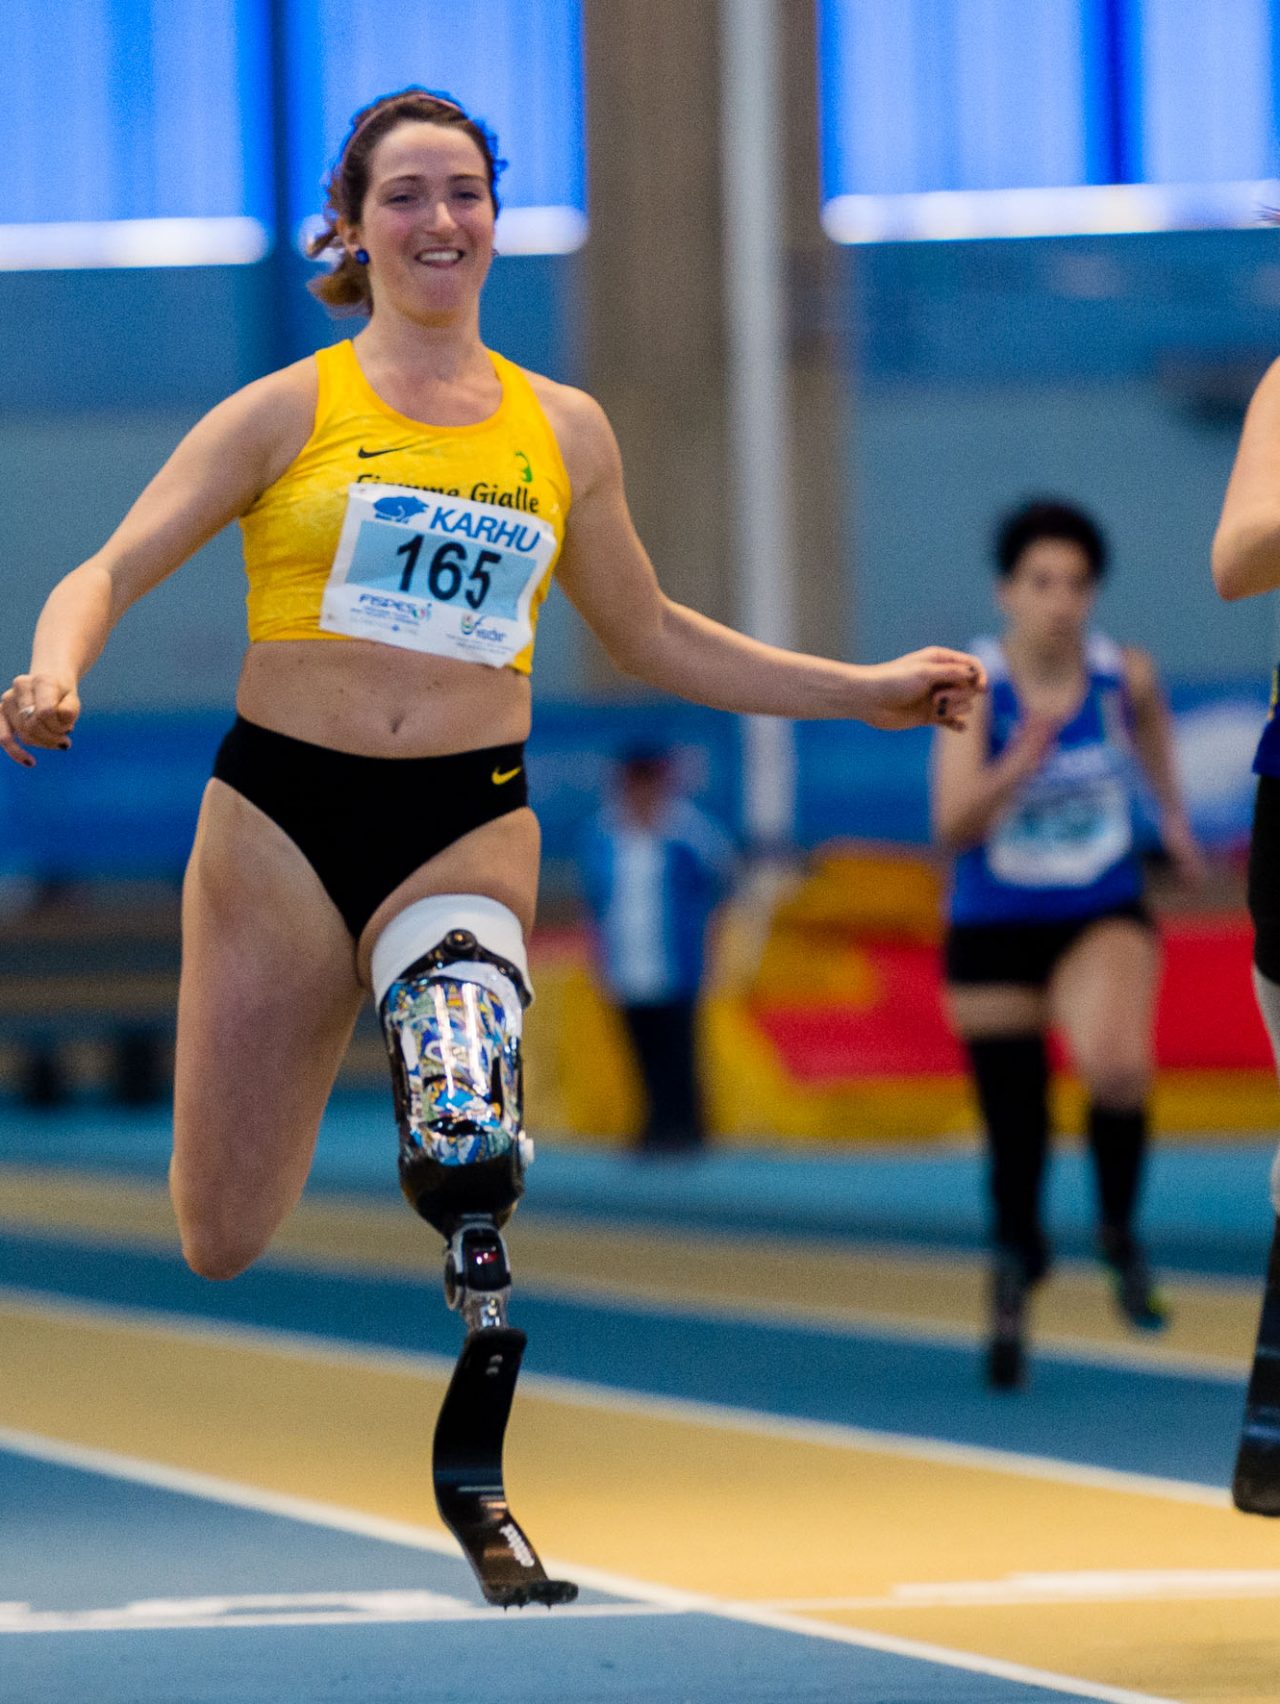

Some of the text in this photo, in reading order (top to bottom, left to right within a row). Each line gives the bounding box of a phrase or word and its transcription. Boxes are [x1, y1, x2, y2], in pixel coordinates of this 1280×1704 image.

[471, 482, 539, 513] Gialle
[429, 506, 540, 552] KARHU
[396, 534, 502, 609] 165
